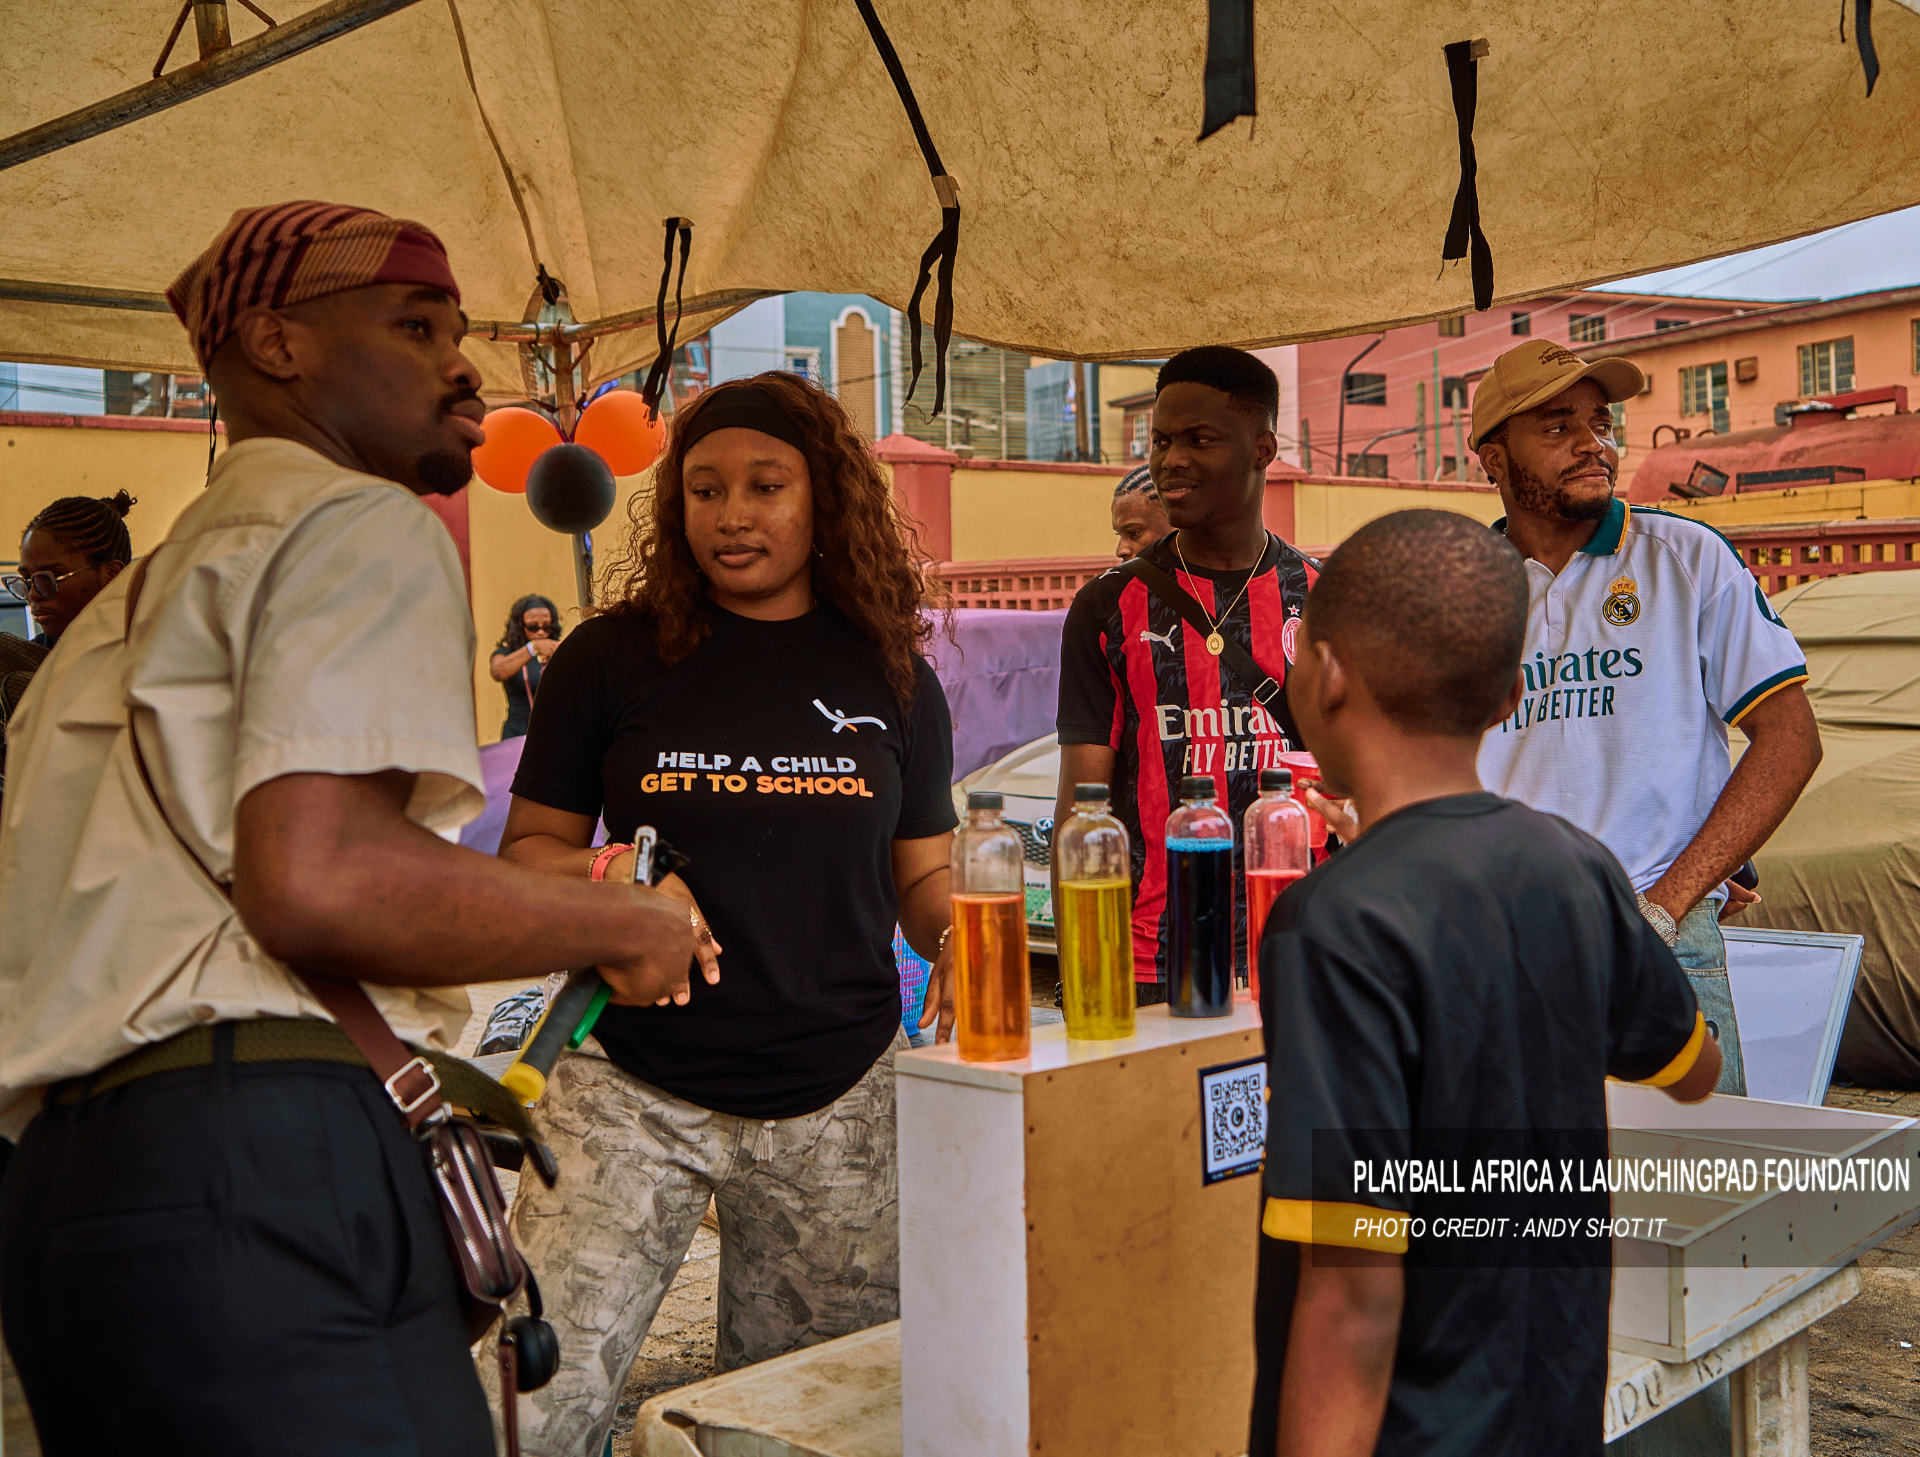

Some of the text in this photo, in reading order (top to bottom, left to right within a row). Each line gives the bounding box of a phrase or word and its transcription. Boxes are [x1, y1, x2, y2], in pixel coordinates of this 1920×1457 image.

[1521, 646, 1643, 692] irates
[1154, 698, 1285, 741] Emirat
[1537, 685, 1615, 723] BETTER
[657, 751, 857, 773] HELP A CHILD
[1182, 743, 1217, 774] FLY
[640, 772, 874, 798] GET TO SCHOOL
